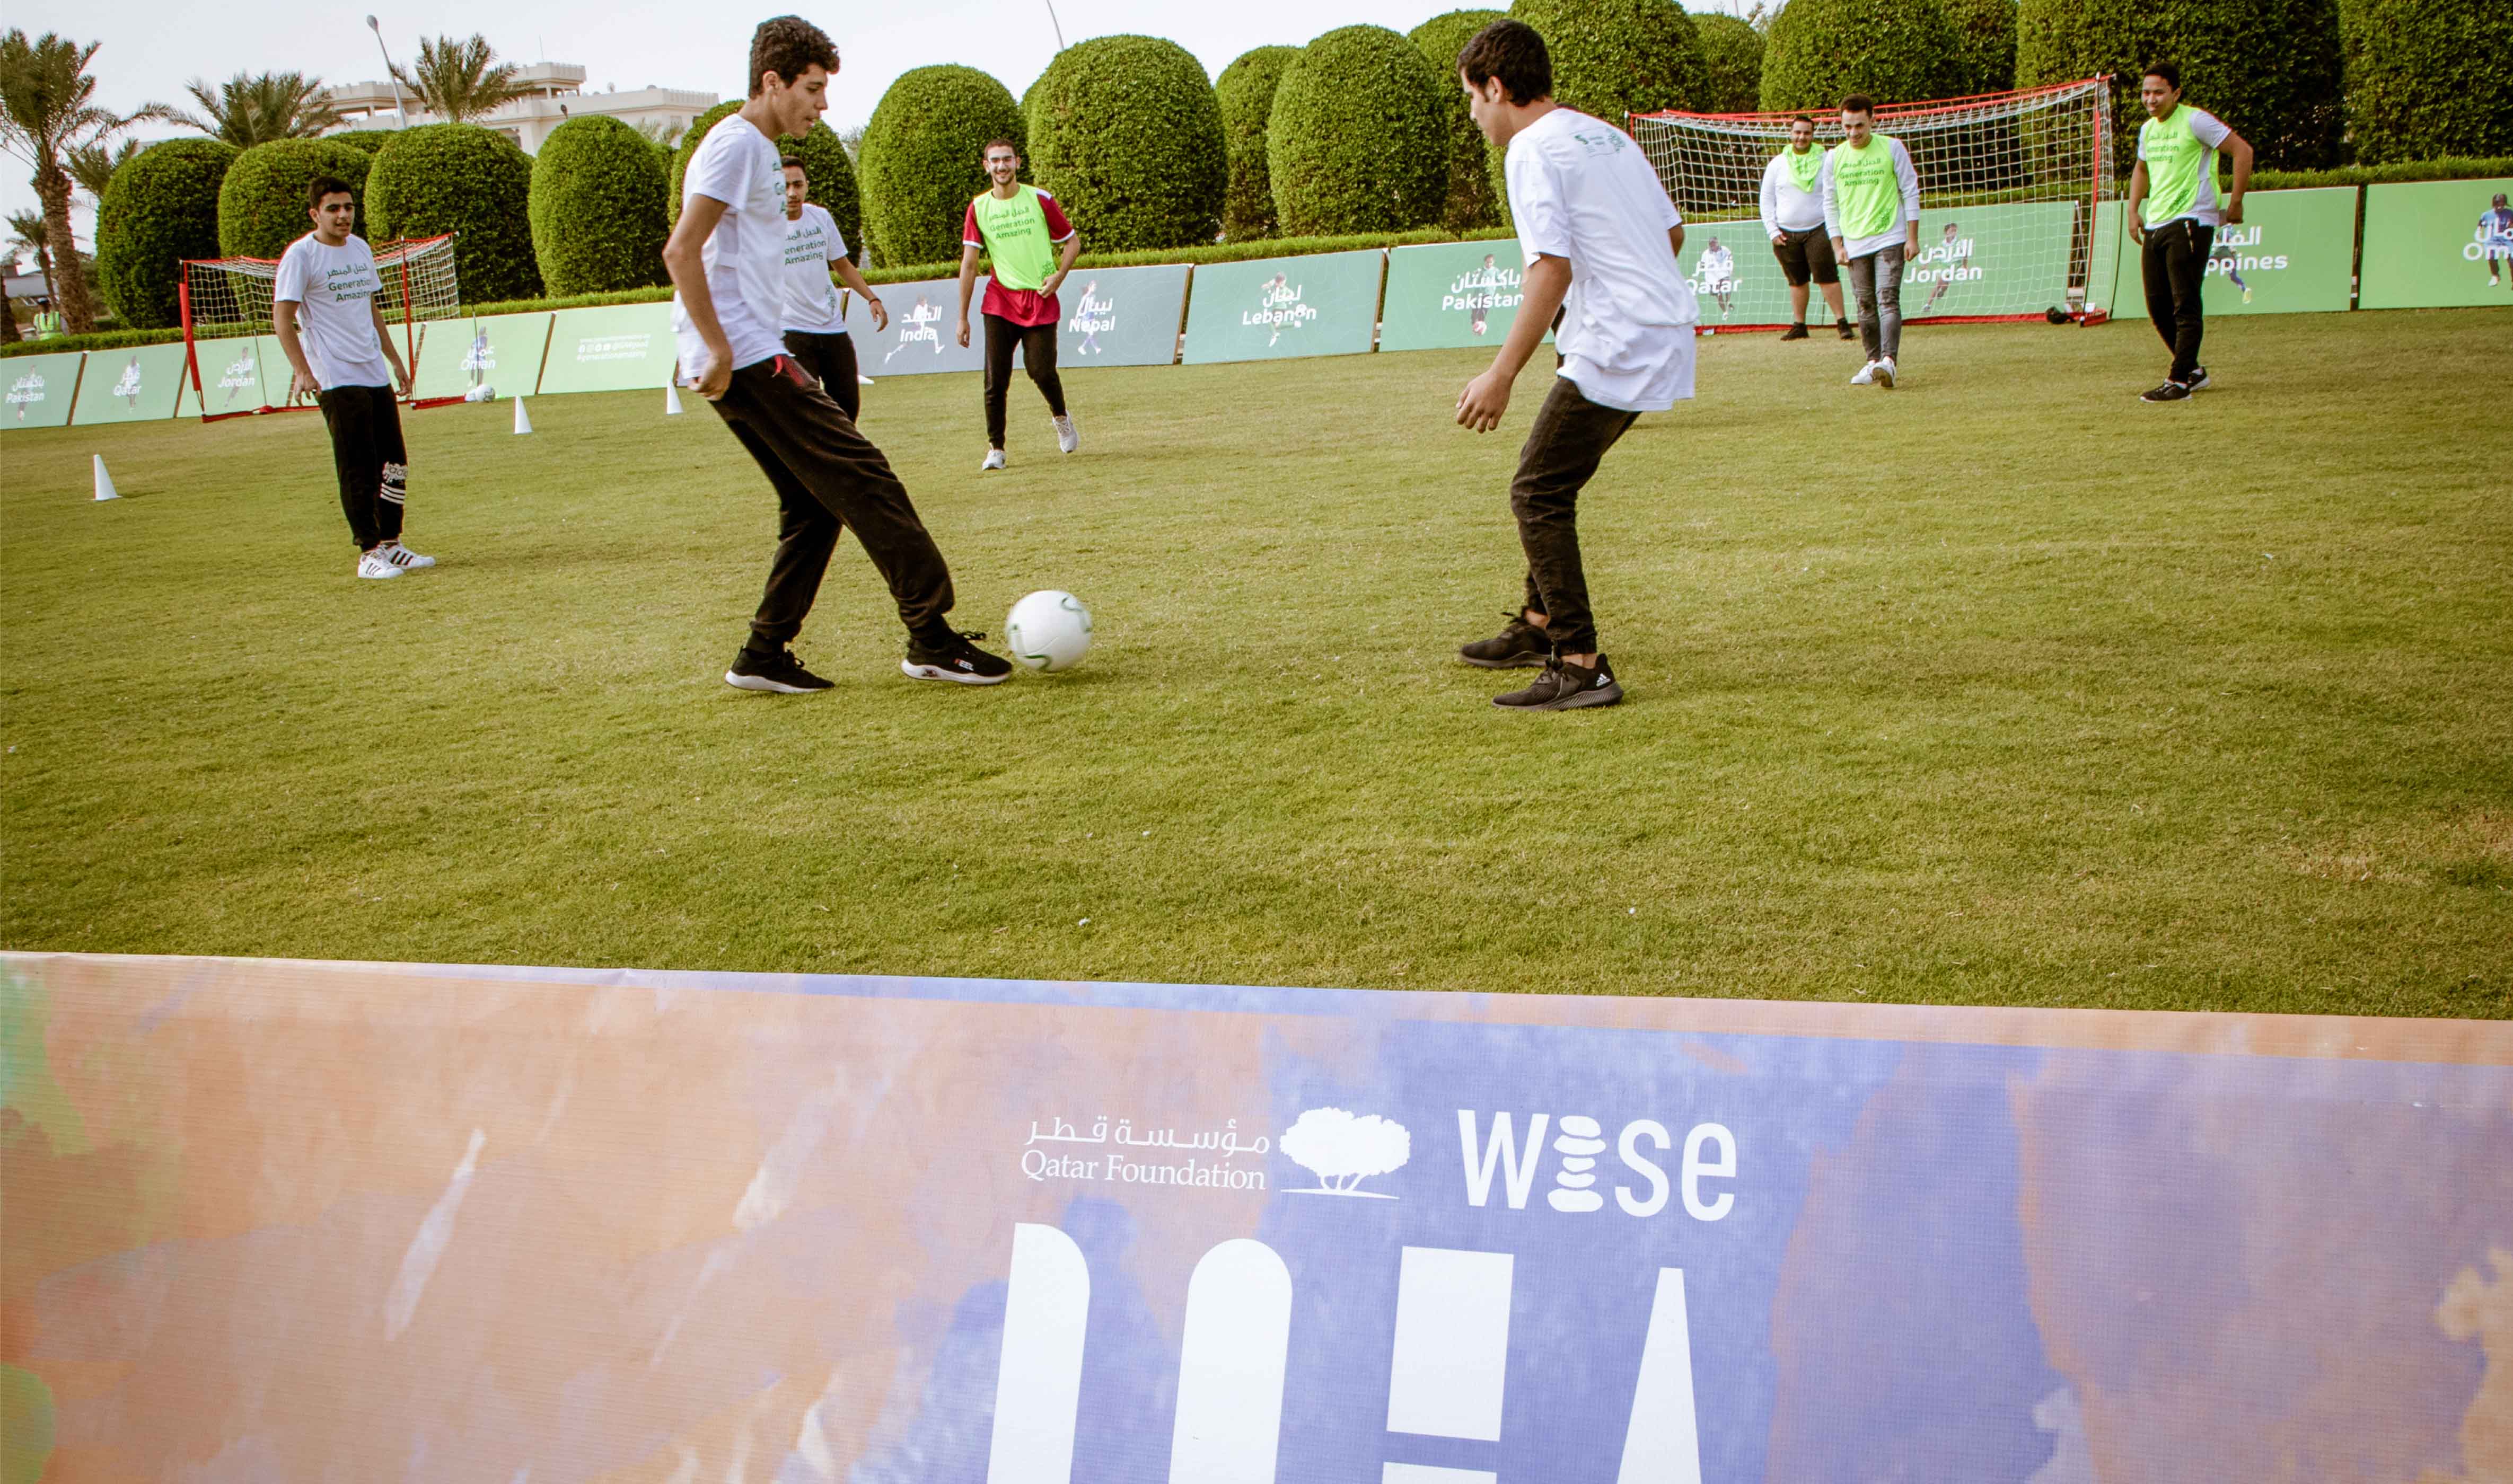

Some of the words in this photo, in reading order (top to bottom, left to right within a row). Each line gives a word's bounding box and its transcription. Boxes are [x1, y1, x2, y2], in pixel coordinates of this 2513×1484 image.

[1840, 170, 1884, 179] Generation
[1844, 178, 1879, 187] Amazing
[990, 218, 1035, 232] Generation
[996, 228, 1031, 239] Amazing
[785, 240, 827, 255] eneration
[785, 252, 823, 266] Amazing
[1451, 268, 1521, 294] باكستان
[1903, 264, 1983, 284] Jordan
[1263, 285, 1302, 308] لبنان
[1078, 296, 1113, 316] نيبال
[1242, 305, 1316, 325] Lebanon
[1069, 315, 1115, 333] Nepal
[900, 326, 937, 342] India
[461, 359, 496, 370] Oman
[217, 375, 255, 387] Jordan
[5, 392, 45, 403] Pakistan
[114, 385, 142, 396] Qatar
[1023, 1115, 1108, 1145] قطر
[1114, 1118, 1270, 1158] مؤسسة
[1021, 1149, 1099, 1181] Qatar
[1104, 1153, 1267, 1190] Foundation
